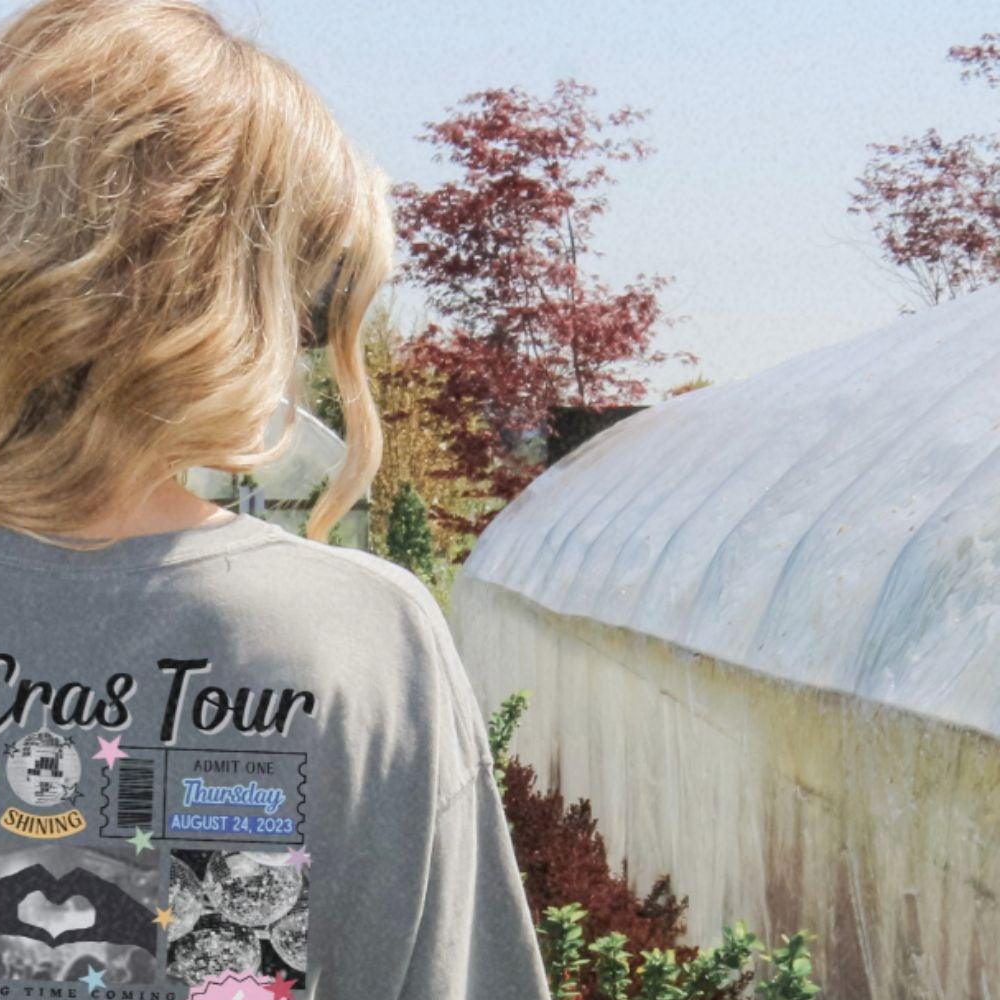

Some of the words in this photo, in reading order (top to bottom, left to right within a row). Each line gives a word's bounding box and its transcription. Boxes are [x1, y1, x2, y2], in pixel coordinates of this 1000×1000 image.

[156, 657, 316, 746] Tour
[193, 759, 240, 774] ADMIT
[245, 761, 274, 775] ONE
[181, 777, 286, 814] Thursday
[3, 808, 83, 835] SHINING
[171, 813, 228, 830] AUGUST
[232, 816, 252, 834] 24,
[256, 817, 293, 833] 2023
[24, 986, 77, 999] TIME
